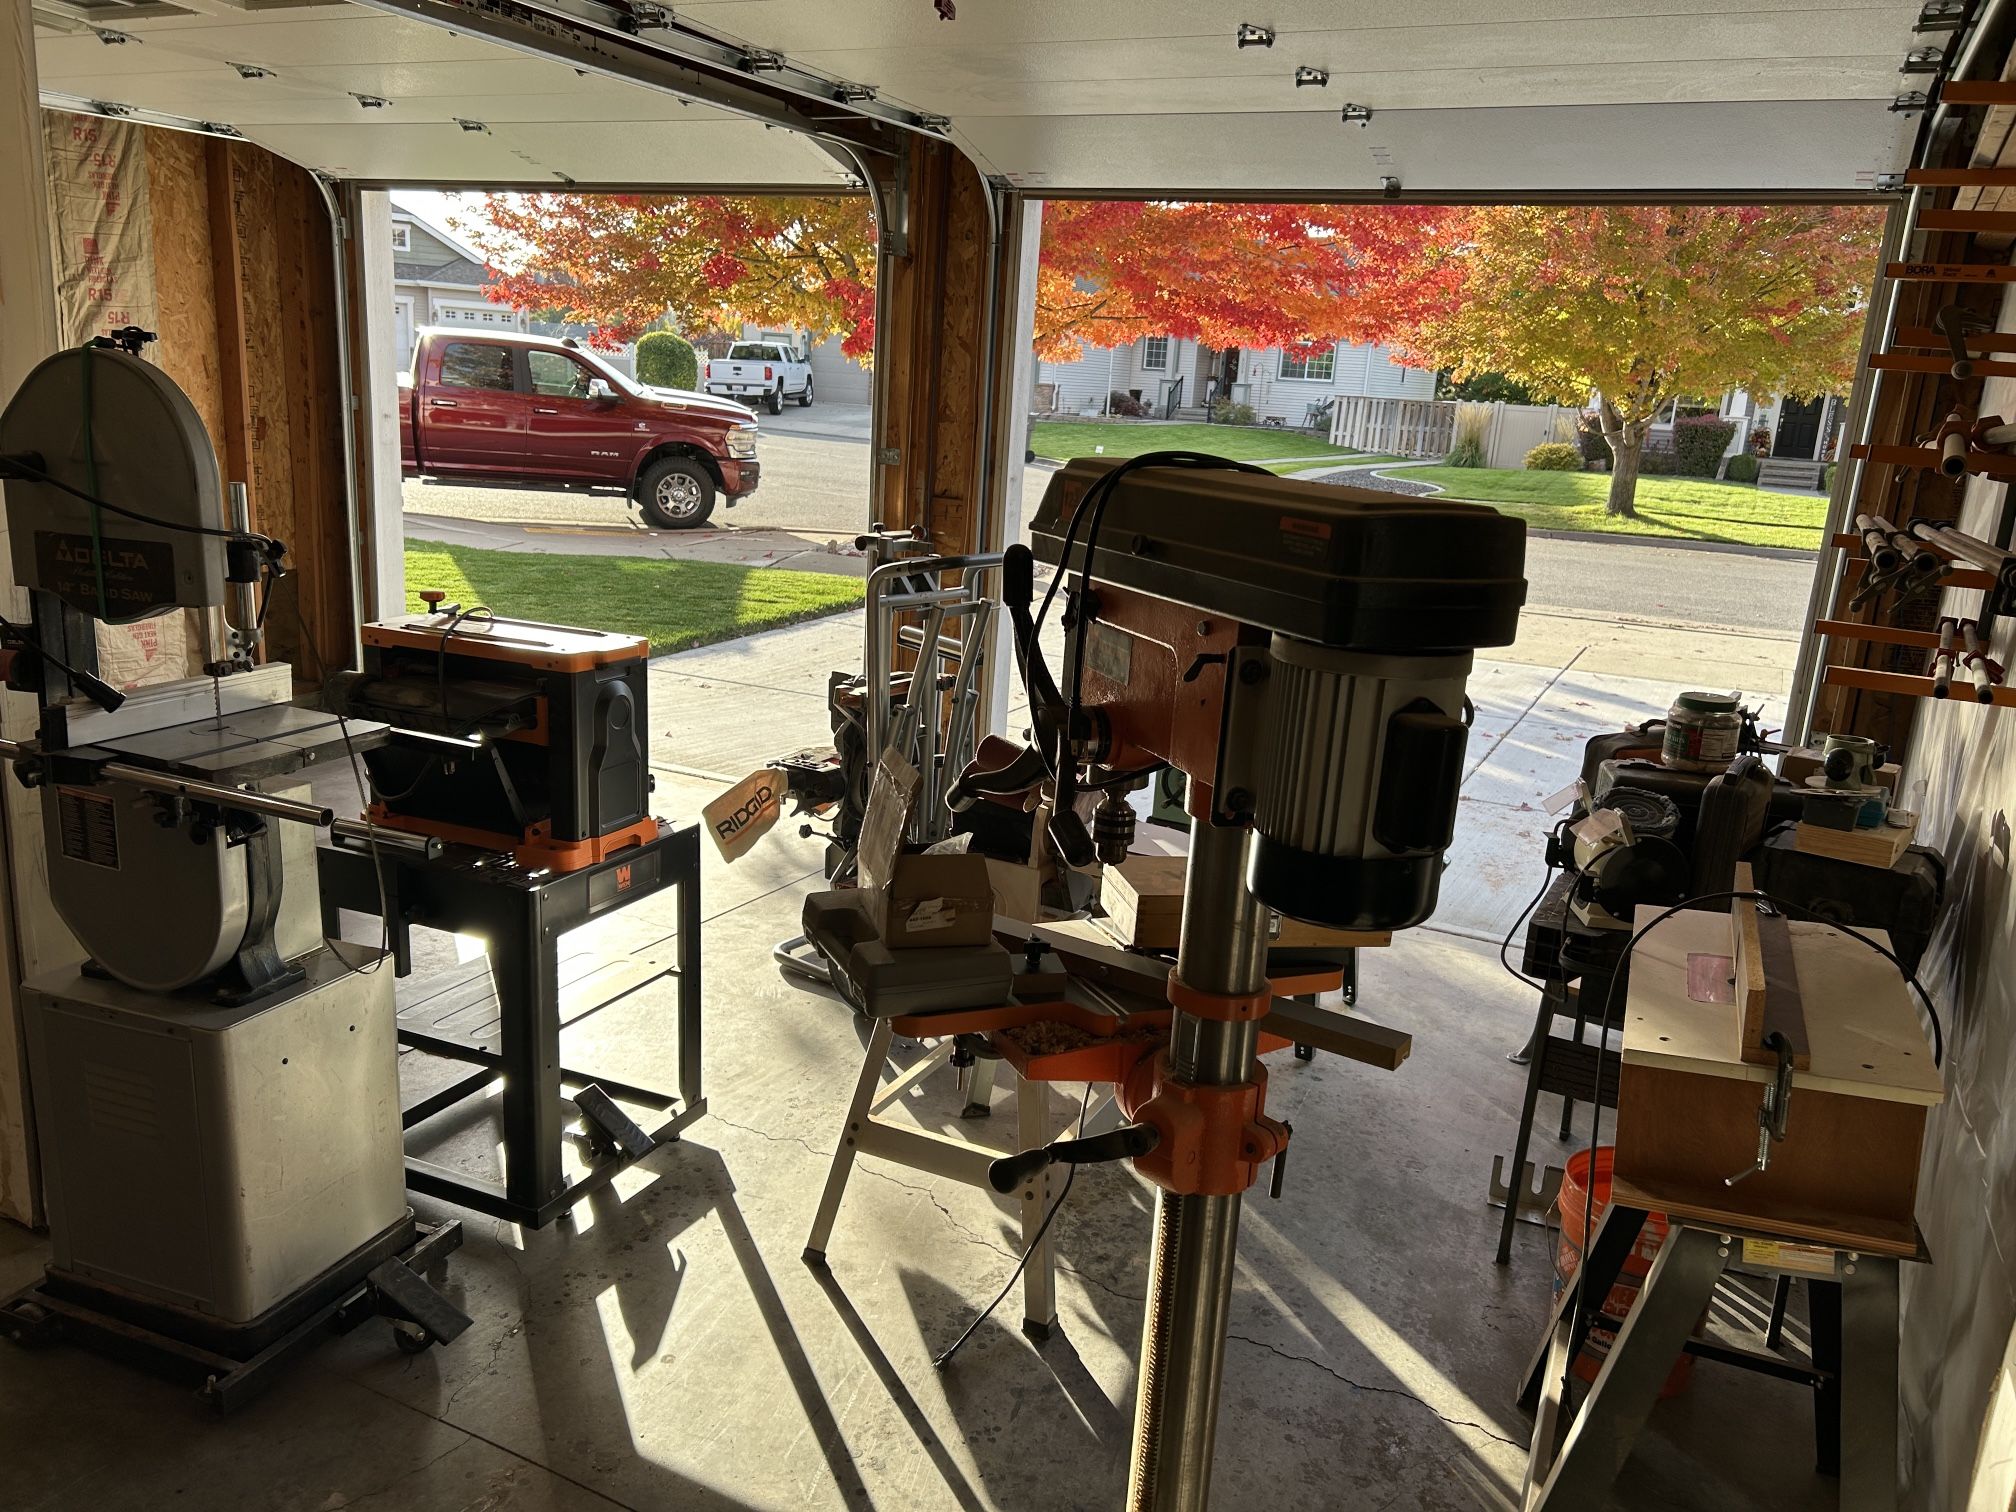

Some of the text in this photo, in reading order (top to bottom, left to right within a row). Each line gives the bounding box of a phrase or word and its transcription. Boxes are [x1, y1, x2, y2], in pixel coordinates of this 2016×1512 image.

[73, 127, 98, 142] R15
[1905, 265, 1936, 275] BORA
[88, 288, 113, 301] R15
[108, 312, 131, 325] R15
[591, 450, 619, 458] RAM
[121, 588, 153, 602] SAW
[715, 786, 772, 840] RIDGID
